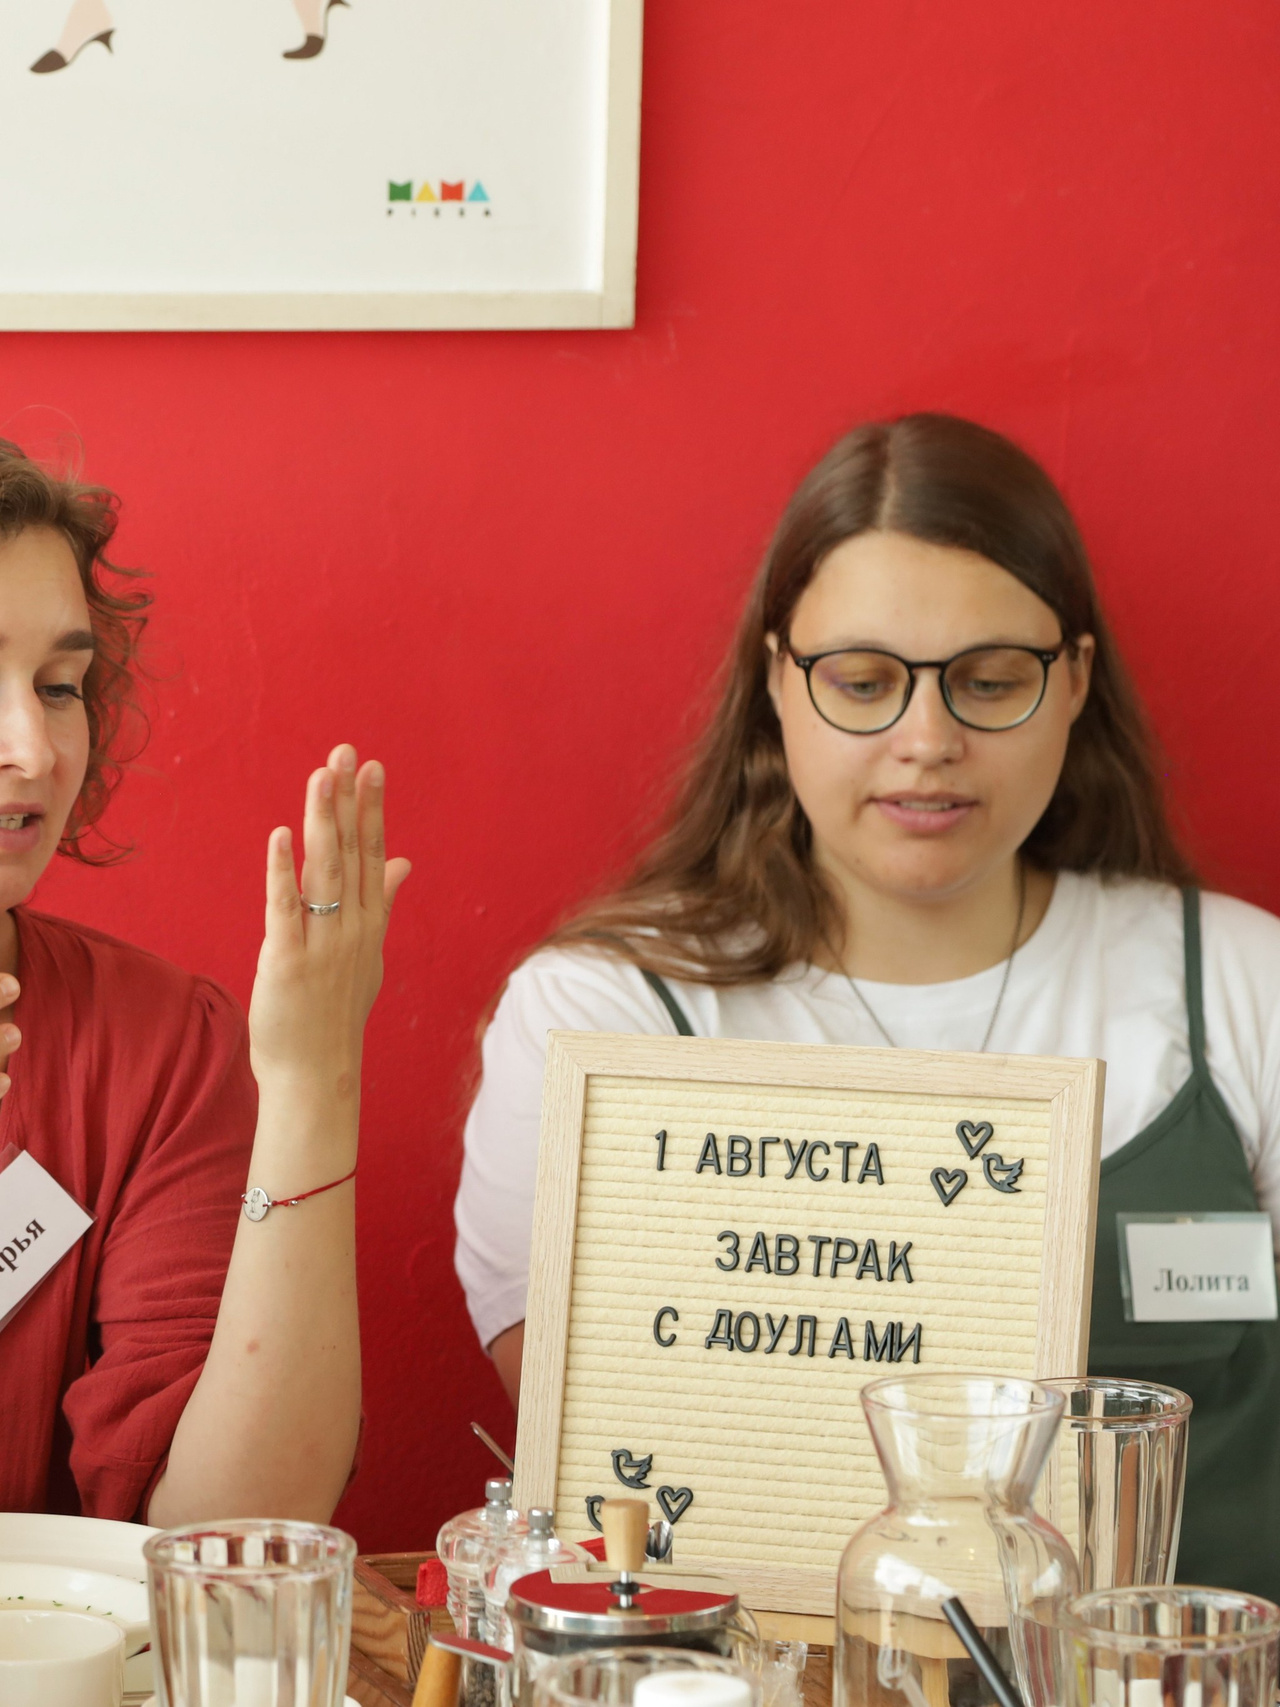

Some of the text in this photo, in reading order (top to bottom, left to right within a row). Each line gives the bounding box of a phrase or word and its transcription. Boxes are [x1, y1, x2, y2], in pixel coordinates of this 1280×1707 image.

[654, 1129, 885, 1186] 1 АВГУСТА
[715, 1230, 914, 1284] ЗАВТРАК
[1153, 1267, 1250, 1292] Лолита
[652, 1306, 923, 1364] С ДОУЛАМИ
